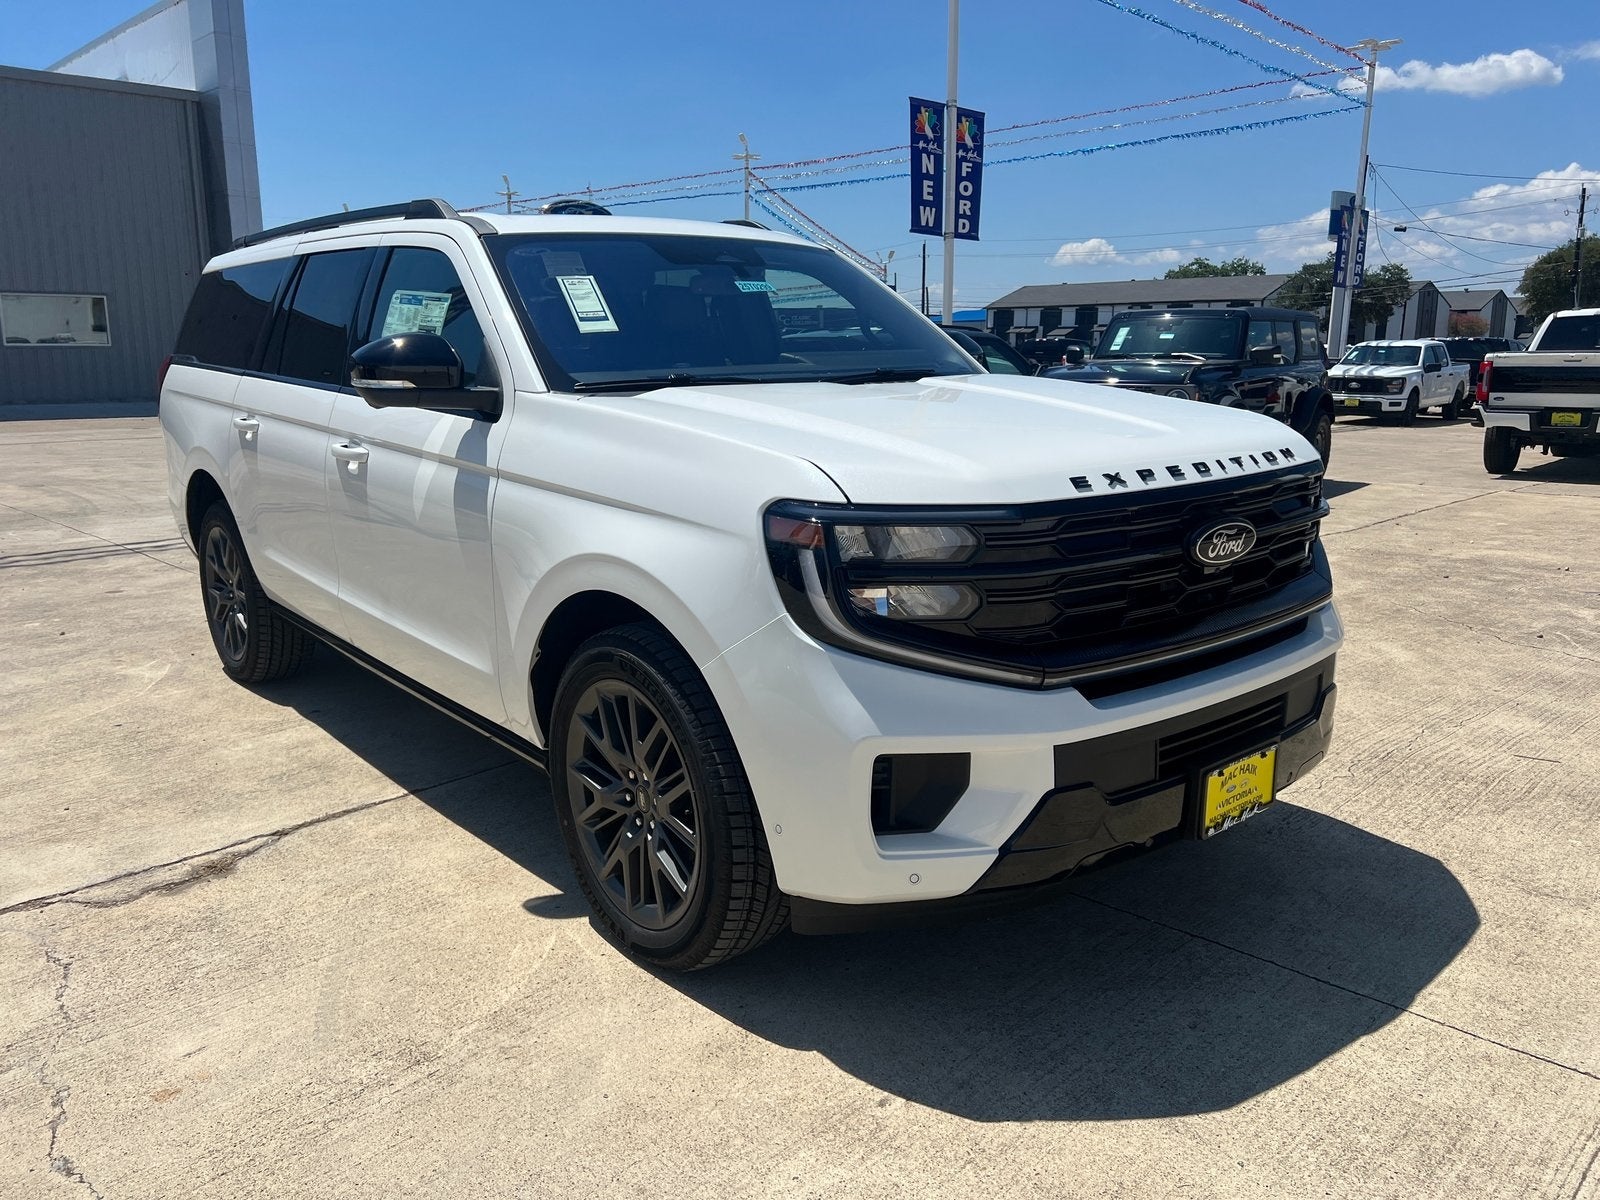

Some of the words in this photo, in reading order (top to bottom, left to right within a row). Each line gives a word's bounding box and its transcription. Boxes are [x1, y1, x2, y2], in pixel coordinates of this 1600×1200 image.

[920, 153, 936, 227] NEW
[958, 161, 973, 233] FORD
[1337, 238, 1348, 284] NEW
[1353, 241, 1364, 285] FORD
[1069, 447, 1296, 491] EXPEDITION
[1208, 528, 1245, 558] Ford
[1220, 767, 1239, 791] MAC
[1239, 763, 1258, 776] HAIK
[1221, 788, 1252, 808] VICTORIA
